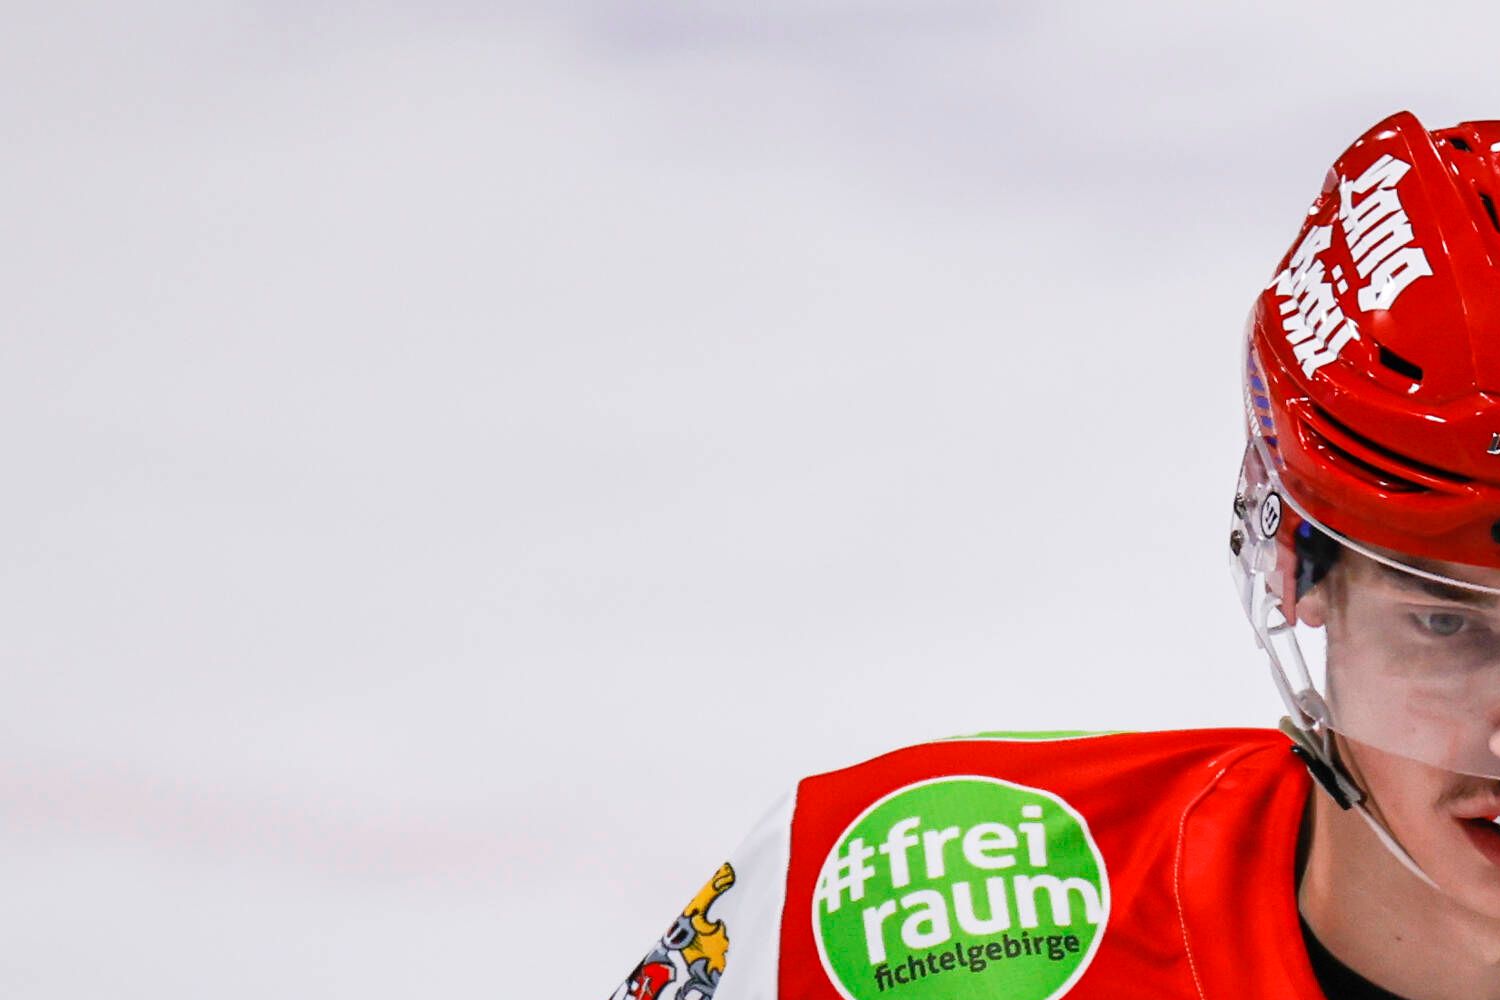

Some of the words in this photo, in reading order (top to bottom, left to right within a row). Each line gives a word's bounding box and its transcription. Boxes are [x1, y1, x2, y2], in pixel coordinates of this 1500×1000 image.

[1339, 153, 1434, 313] Lang
[820, 805, 1048, 914] #frei
[863, 873, 1103, 966] raum
[874, 931, 1081, 992] fichtelgebirge
